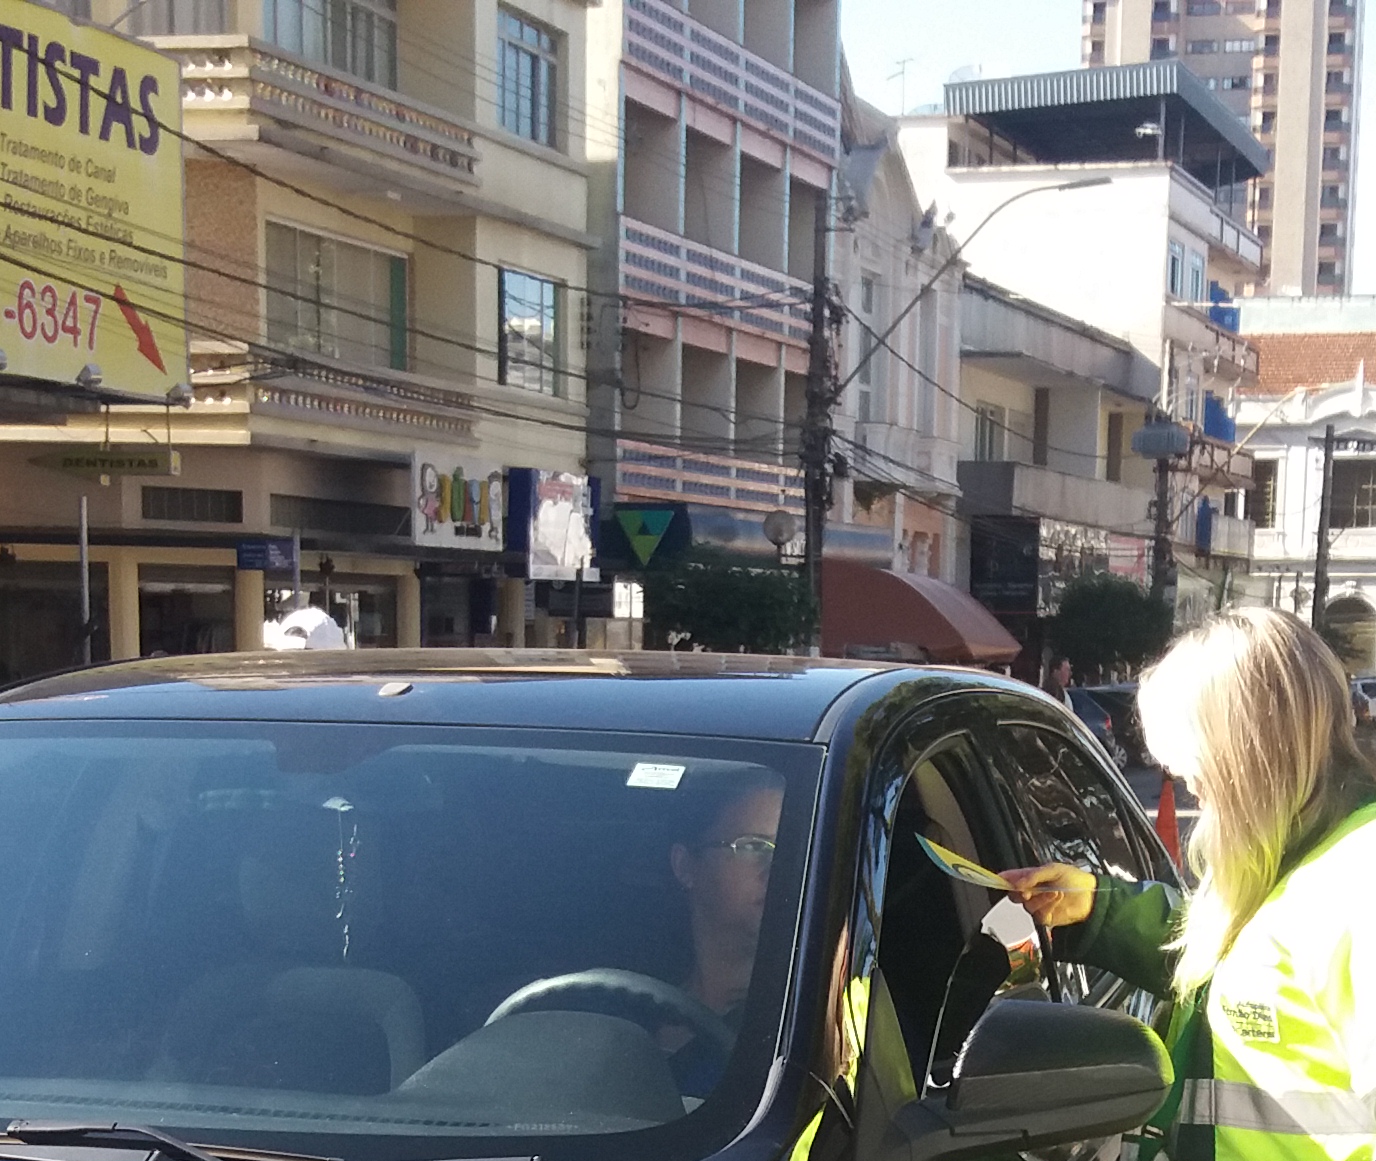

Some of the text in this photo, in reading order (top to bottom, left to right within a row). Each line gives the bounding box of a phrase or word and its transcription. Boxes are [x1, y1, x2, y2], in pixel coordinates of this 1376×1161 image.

[0, 132, 117, 184] Tratamento de Canal
[0, 161, 130, 218] Tratamento de Gengiva
[3, 223, 64, 254] Aparelhos
[66, 238, 96, 263] Fixos
[99, 250, 106, 262] e
[62, 457, 159, 469] DENTISTAS
